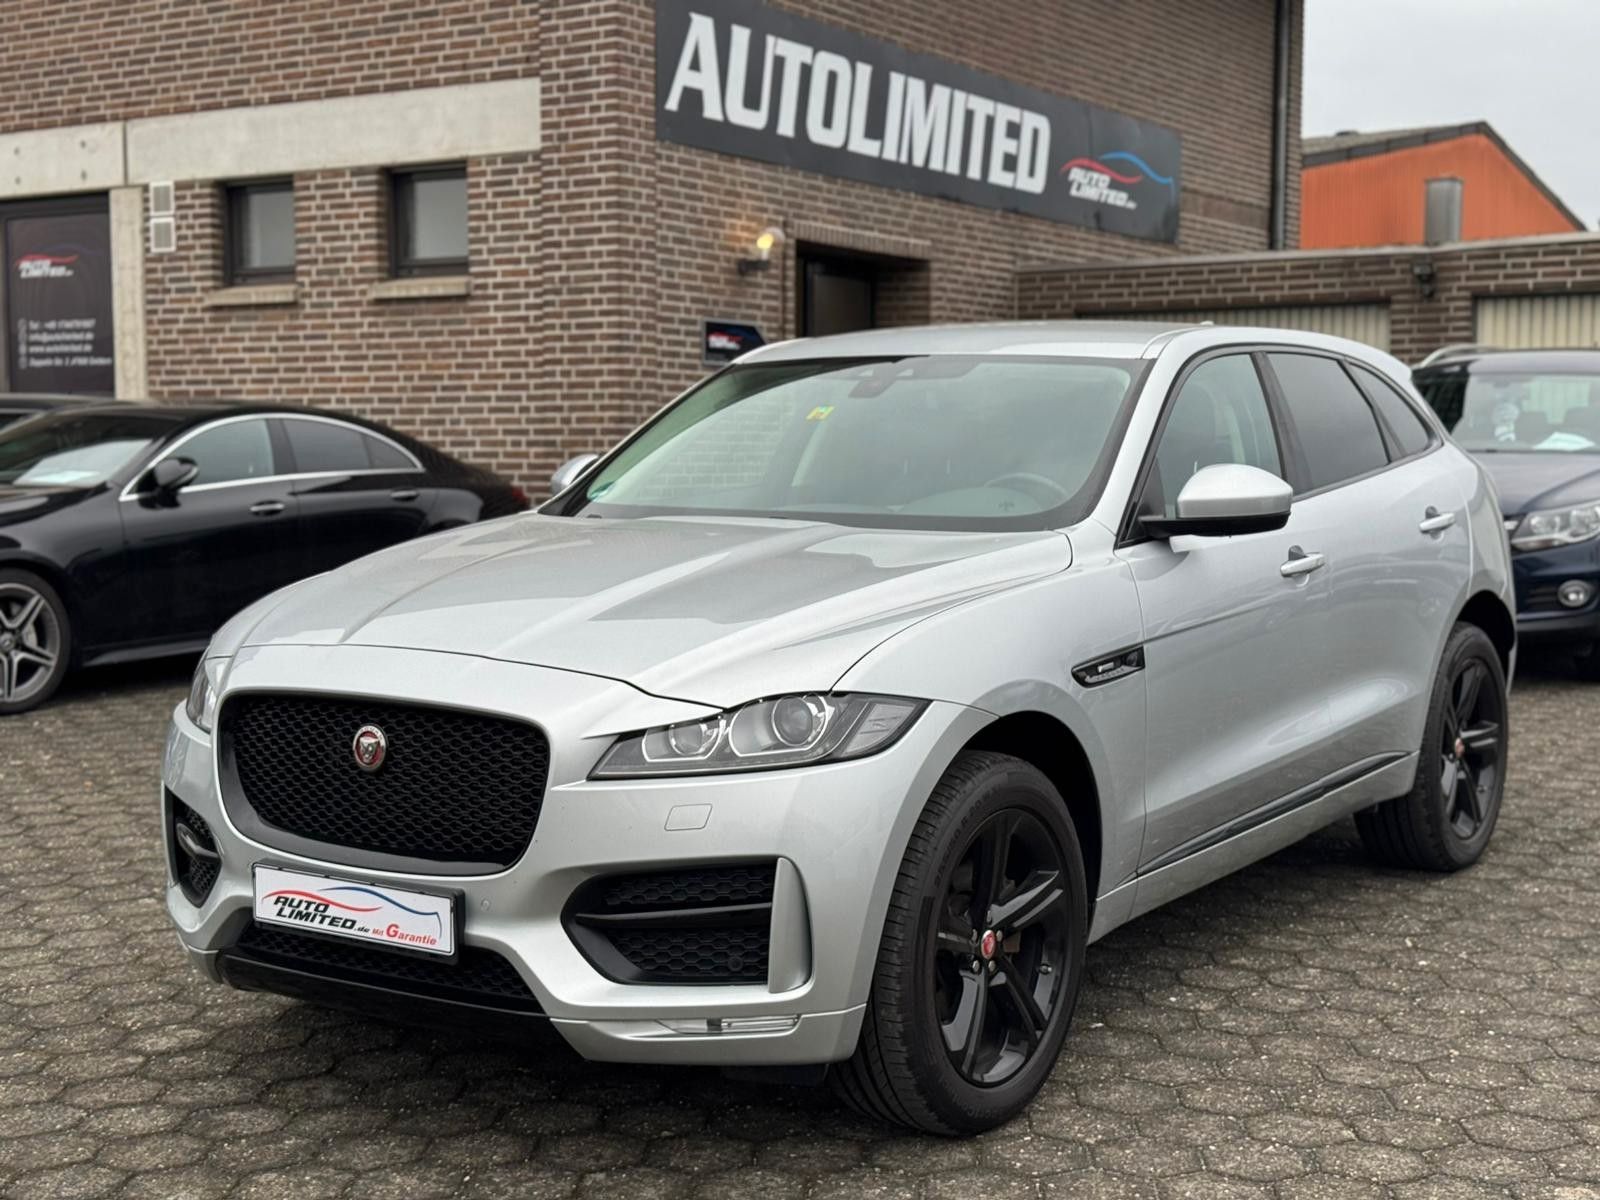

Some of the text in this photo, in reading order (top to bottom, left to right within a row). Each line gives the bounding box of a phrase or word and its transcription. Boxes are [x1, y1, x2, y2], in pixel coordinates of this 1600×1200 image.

[664, 11, 1051, 195] AUTOLIMITED
[1068, 166, 1111, 190] AUTO
[273, 895, 331, 914] AUTO
[385, 922, 437, 946] Garantie
